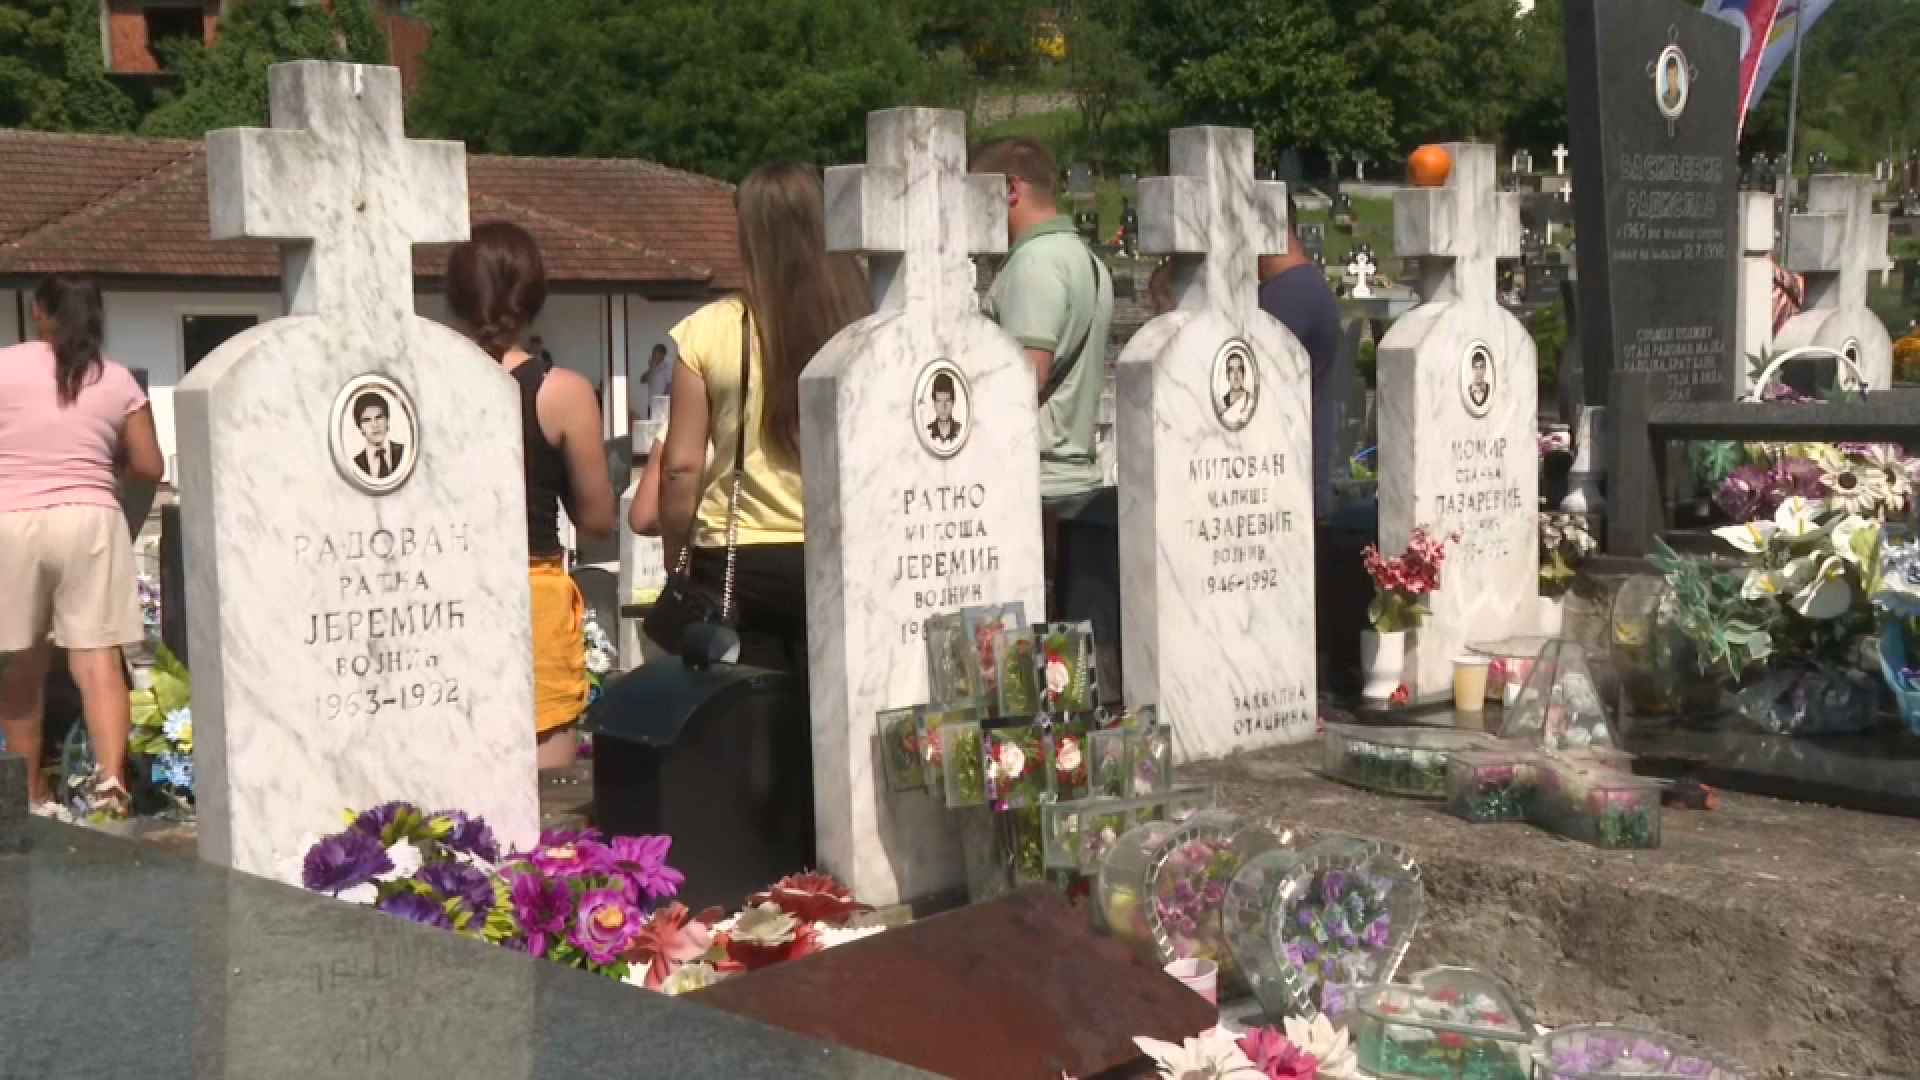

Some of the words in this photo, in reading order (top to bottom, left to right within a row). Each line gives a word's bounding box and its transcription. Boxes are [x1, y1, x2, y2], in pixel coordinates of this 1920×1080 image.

[1189, 454, 1285, 482] МИЛОВАН
[294, 523, 468, 564] РАДОВАН
[1184, 511, 1292, 542] ЛАЗАРЕВИЋ
[894, 546, 998, 581] ЈЕРЕМИЋ
[304, 600, 465, 645] ЈЕРЕМИЋ
